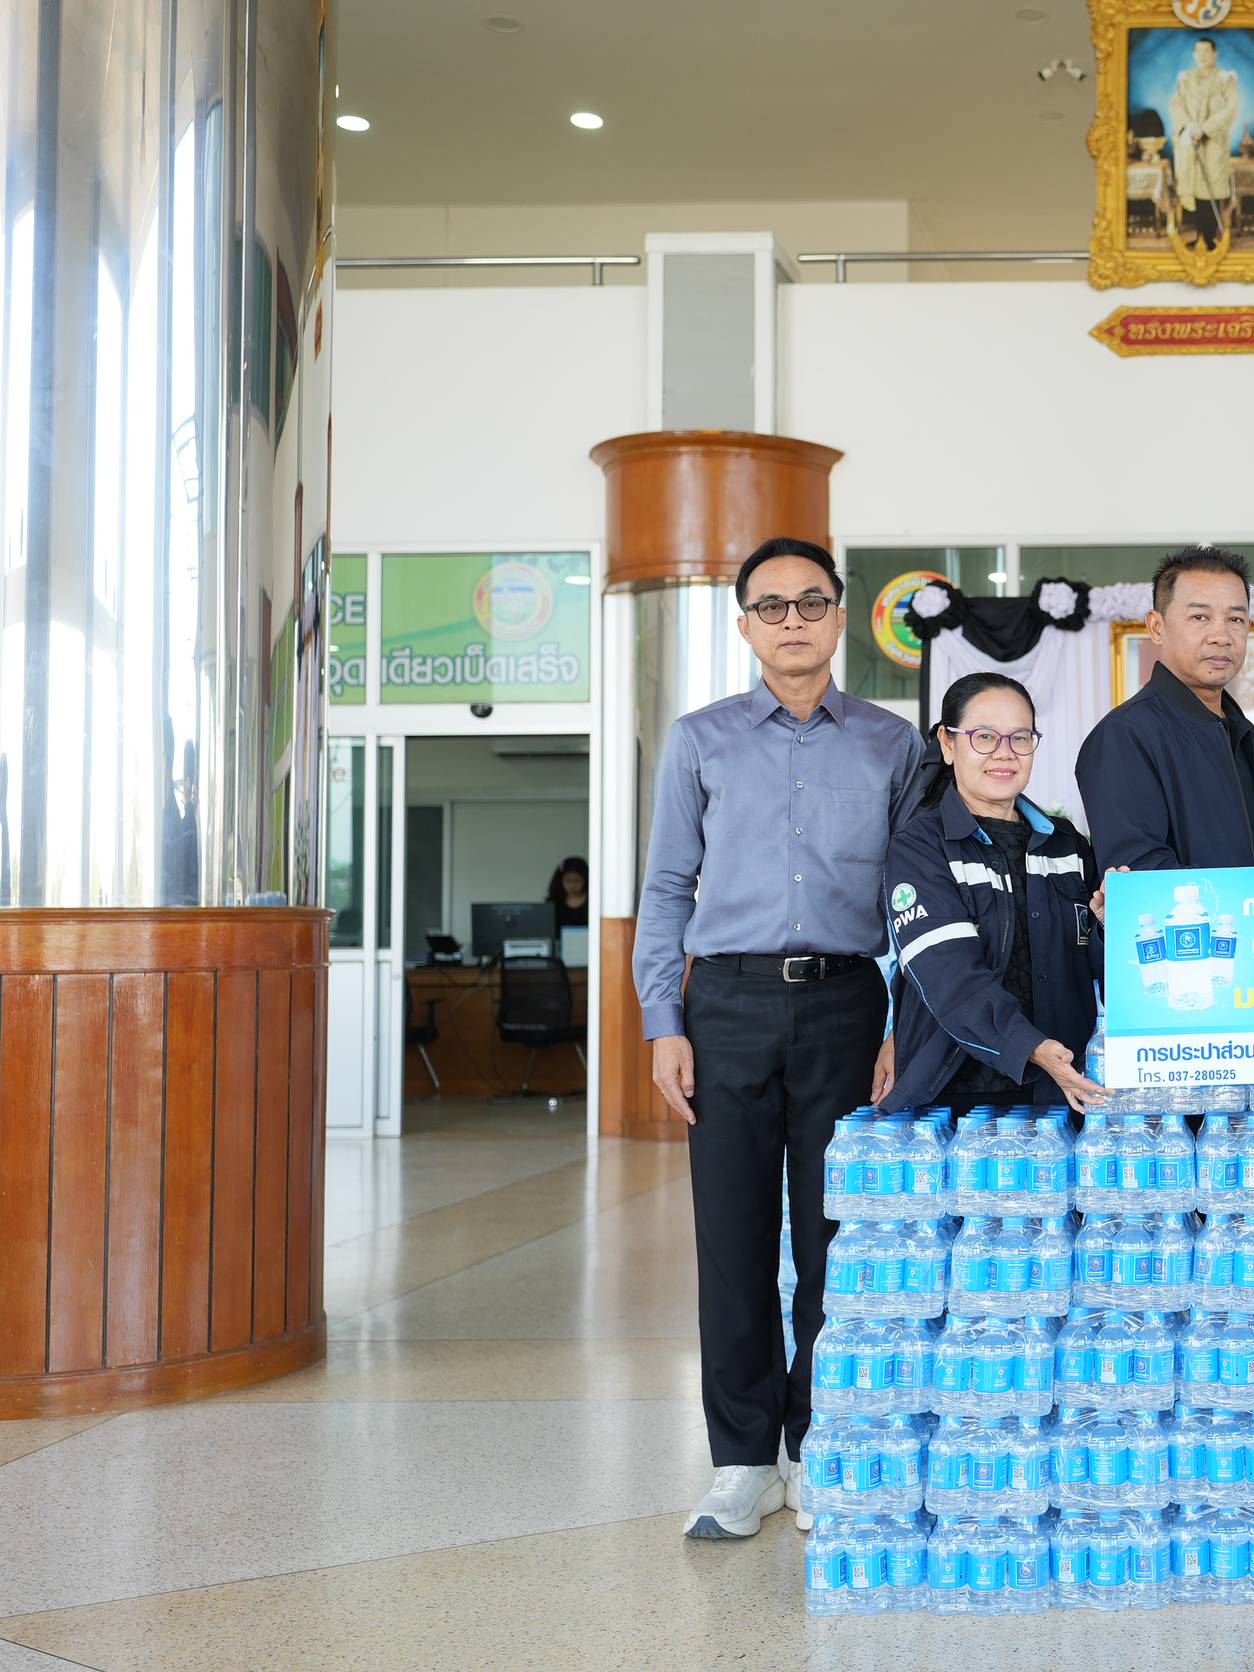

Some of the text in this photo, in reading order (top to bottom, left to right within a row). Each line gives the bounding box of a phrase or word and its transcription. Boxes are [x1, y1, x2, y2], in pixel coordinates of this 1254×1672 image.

[893, 904, 929, 934] PWA
[1137, 1068, 1236, 1084] โทร. 037-280525
